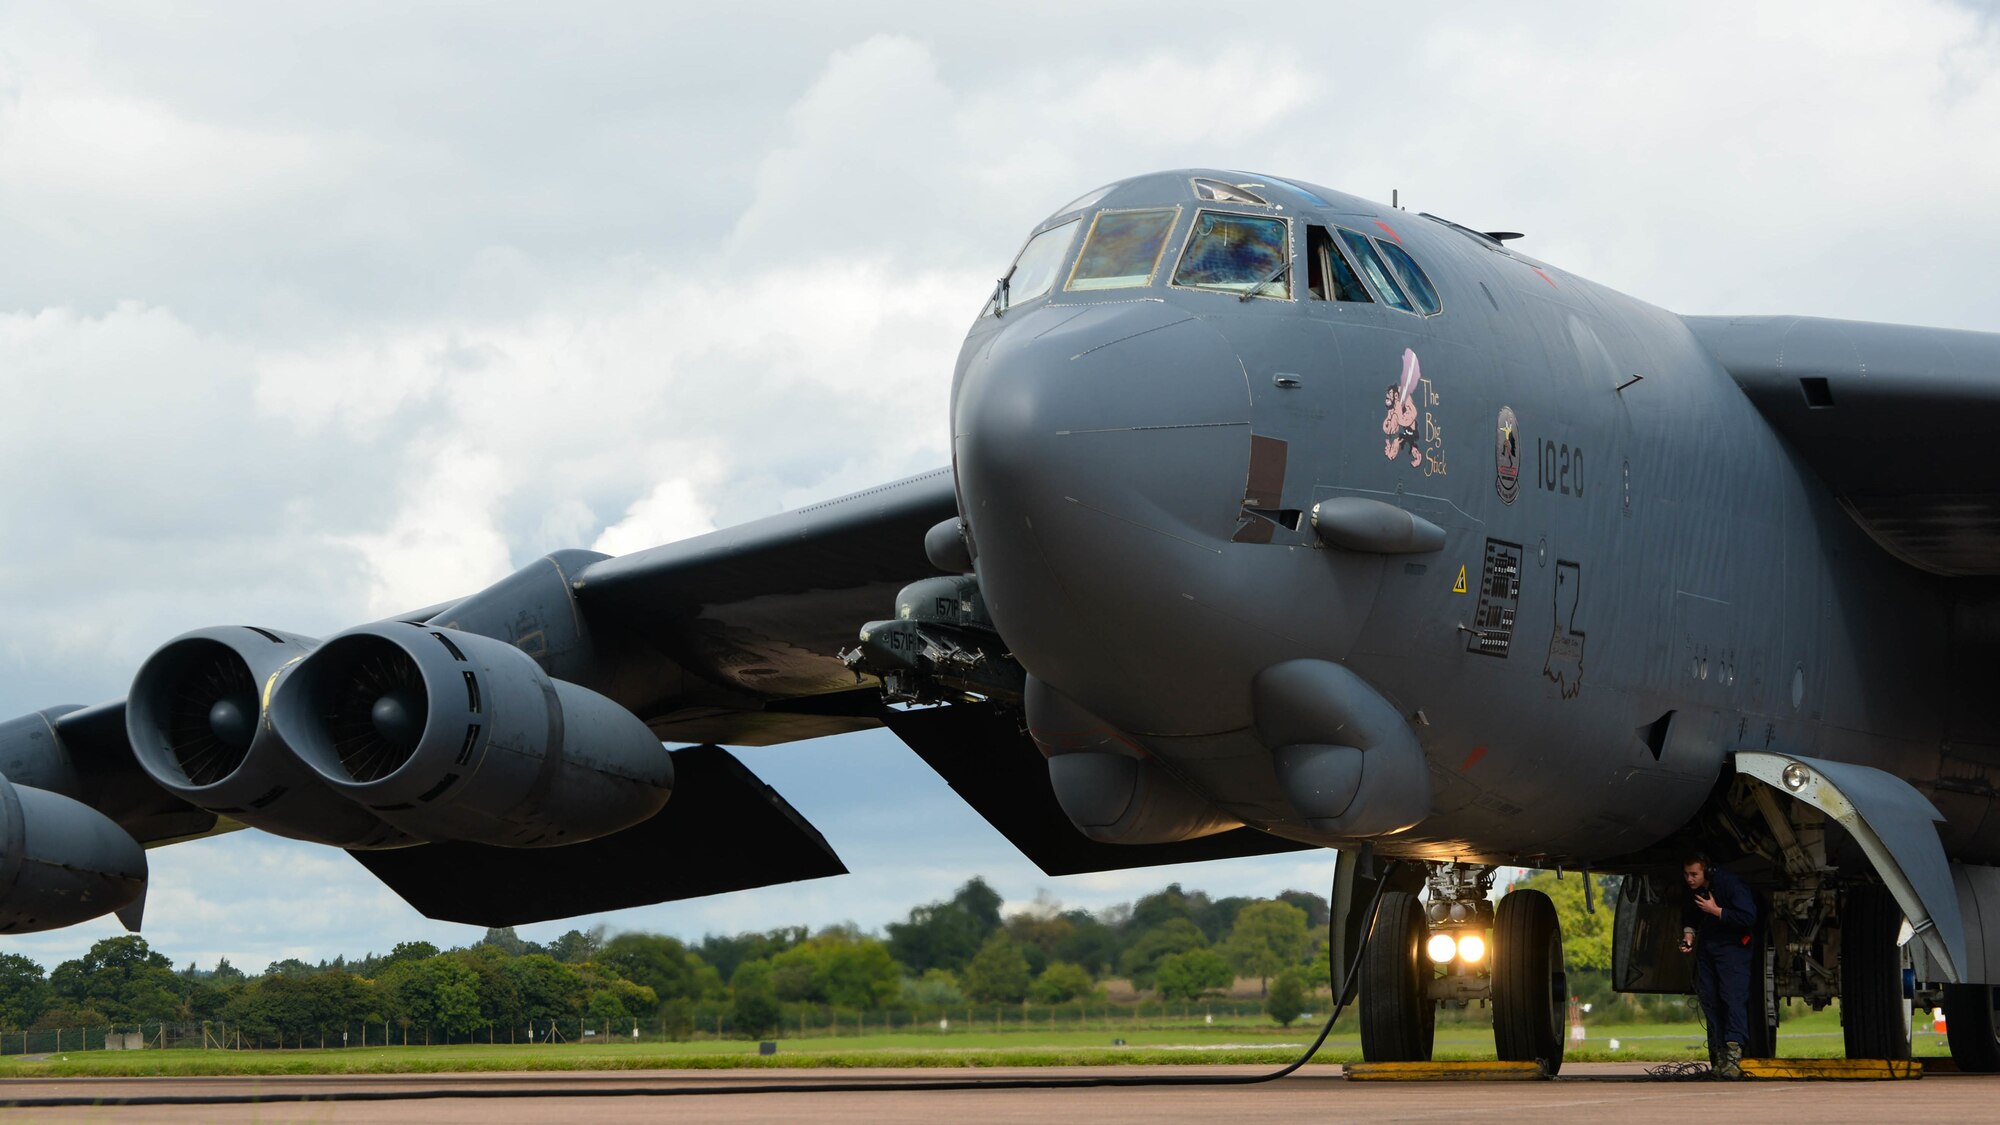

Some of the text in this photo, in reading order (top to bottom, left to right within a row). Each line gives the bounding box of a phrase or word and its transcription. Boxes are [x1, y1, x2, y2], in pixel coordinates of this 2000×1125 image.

[1420, 378, 1440, 408] The
[1424, 412, 1442, 448] Big
[1423, 448, 1447, 478] Stick
[1538, 437, 1584, 498] 1020
